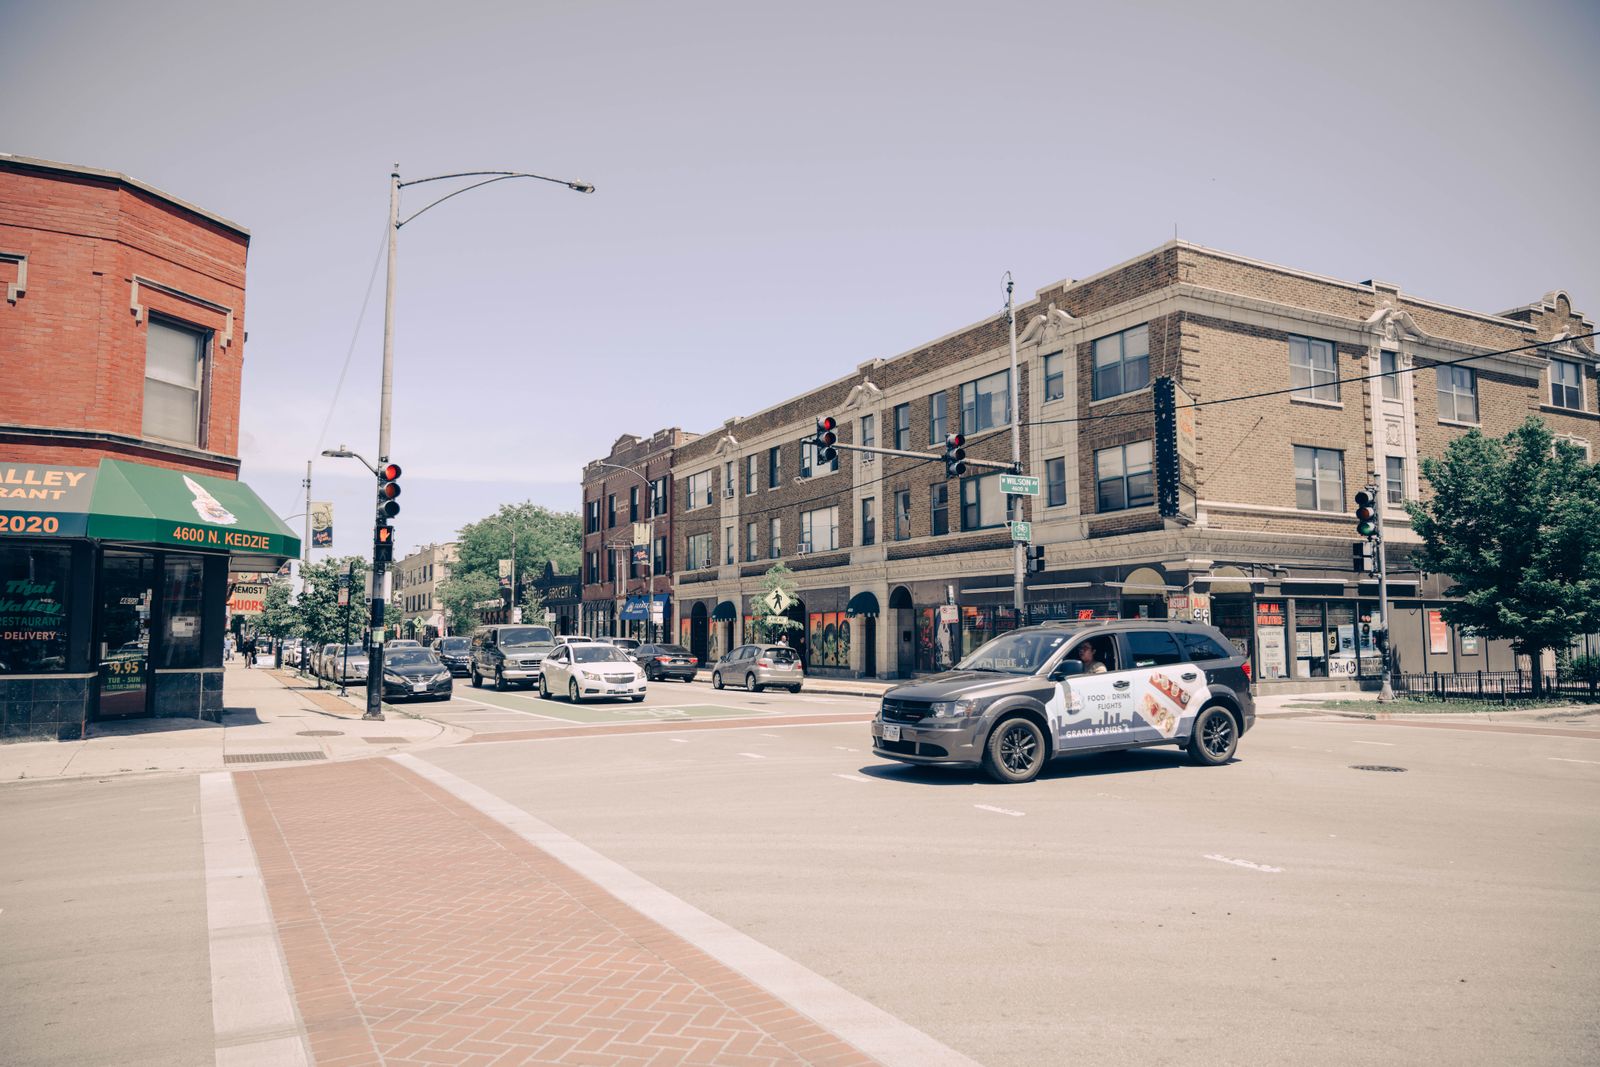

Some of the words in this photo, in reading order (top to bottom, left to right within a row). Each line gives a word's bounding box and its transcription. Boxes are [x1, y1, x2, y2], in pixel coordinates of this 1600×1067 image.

[0, 468, 87, 487] LLEY
[1007, 477, 1031, 486] WILSON
[173, 526, 204, 542] 4600
[208, 530, 221, 544] N.
[224, 532, 270, 550] KEDZIE
[6, 579, 56, 596] Thai
[548, 585, 572, 599] GROCERY
[0, 616, 62, 626] ESTAURANT
[109, 661, 139, 674] $9.95
[1330, 661, 1346, 673] A-Plus
[1087, 694, 1106, 702] FOOD
[1112, 692, 1131, 700] DRINK
[1097, 702, 1122, 710] FLIGHTS
[1065, 727, 1093, 738] GRAND
[1095, 725, 1122, 736] RAPIDS
